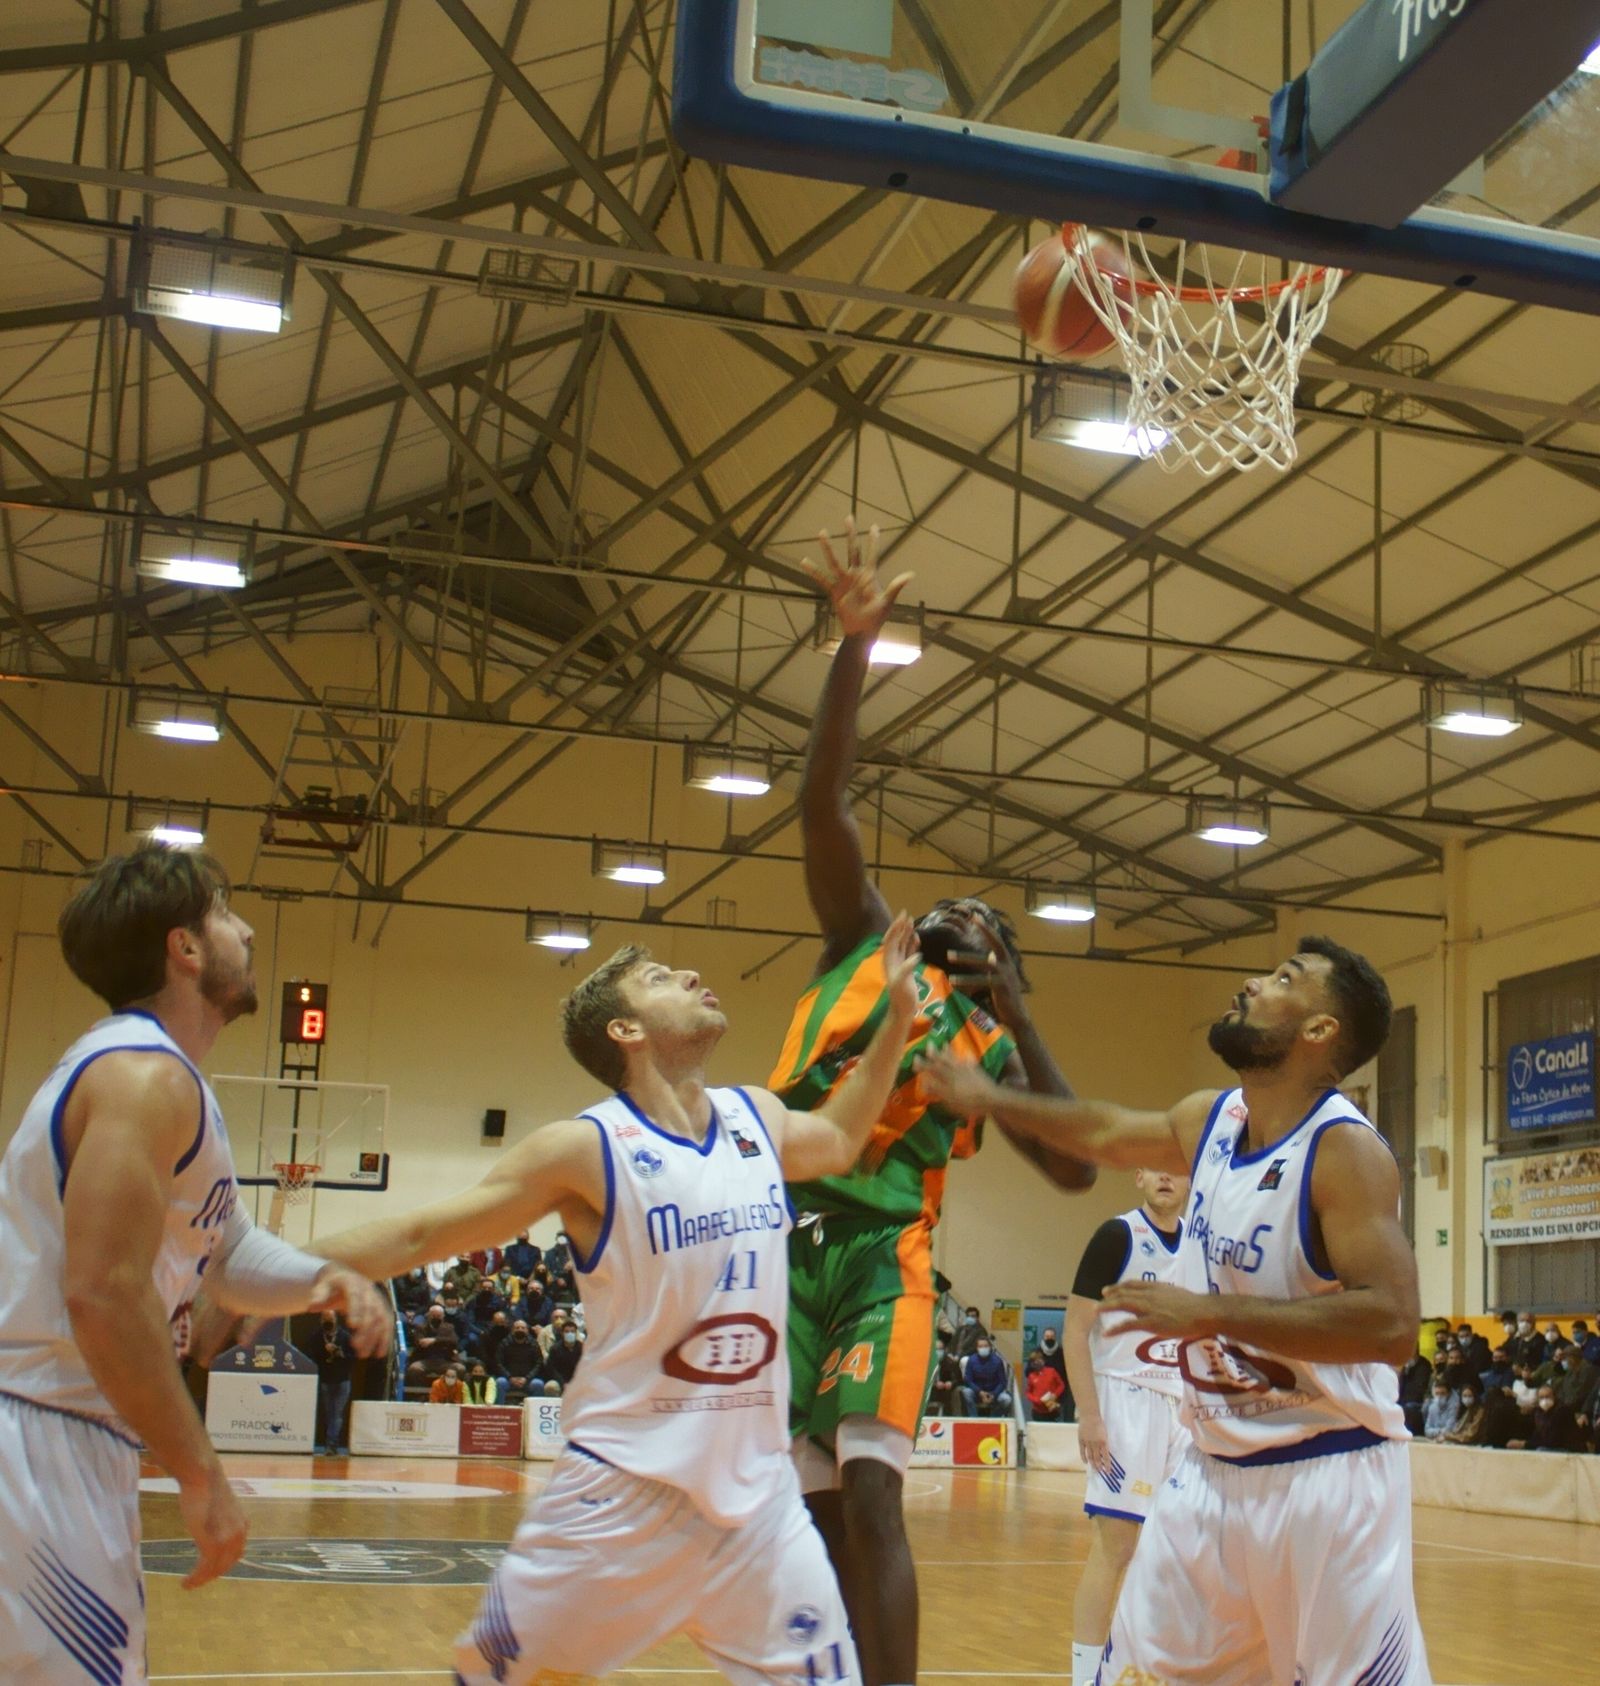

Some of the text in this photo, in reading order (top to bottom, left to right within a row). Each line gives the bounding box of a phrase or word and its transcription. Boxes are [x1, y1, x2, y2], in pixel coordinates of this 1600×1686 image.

[302, 1010, 324, 1039] 8
[1490, 1225, 1530, 1239] RENDIRSE
[1532, 1225, 1544, 1237] NO
[1546, 1223, 1556, 1235] ES
[1557, 1222, 1574, 1235] UNA
[716, 1250, 759, 1292] 41
